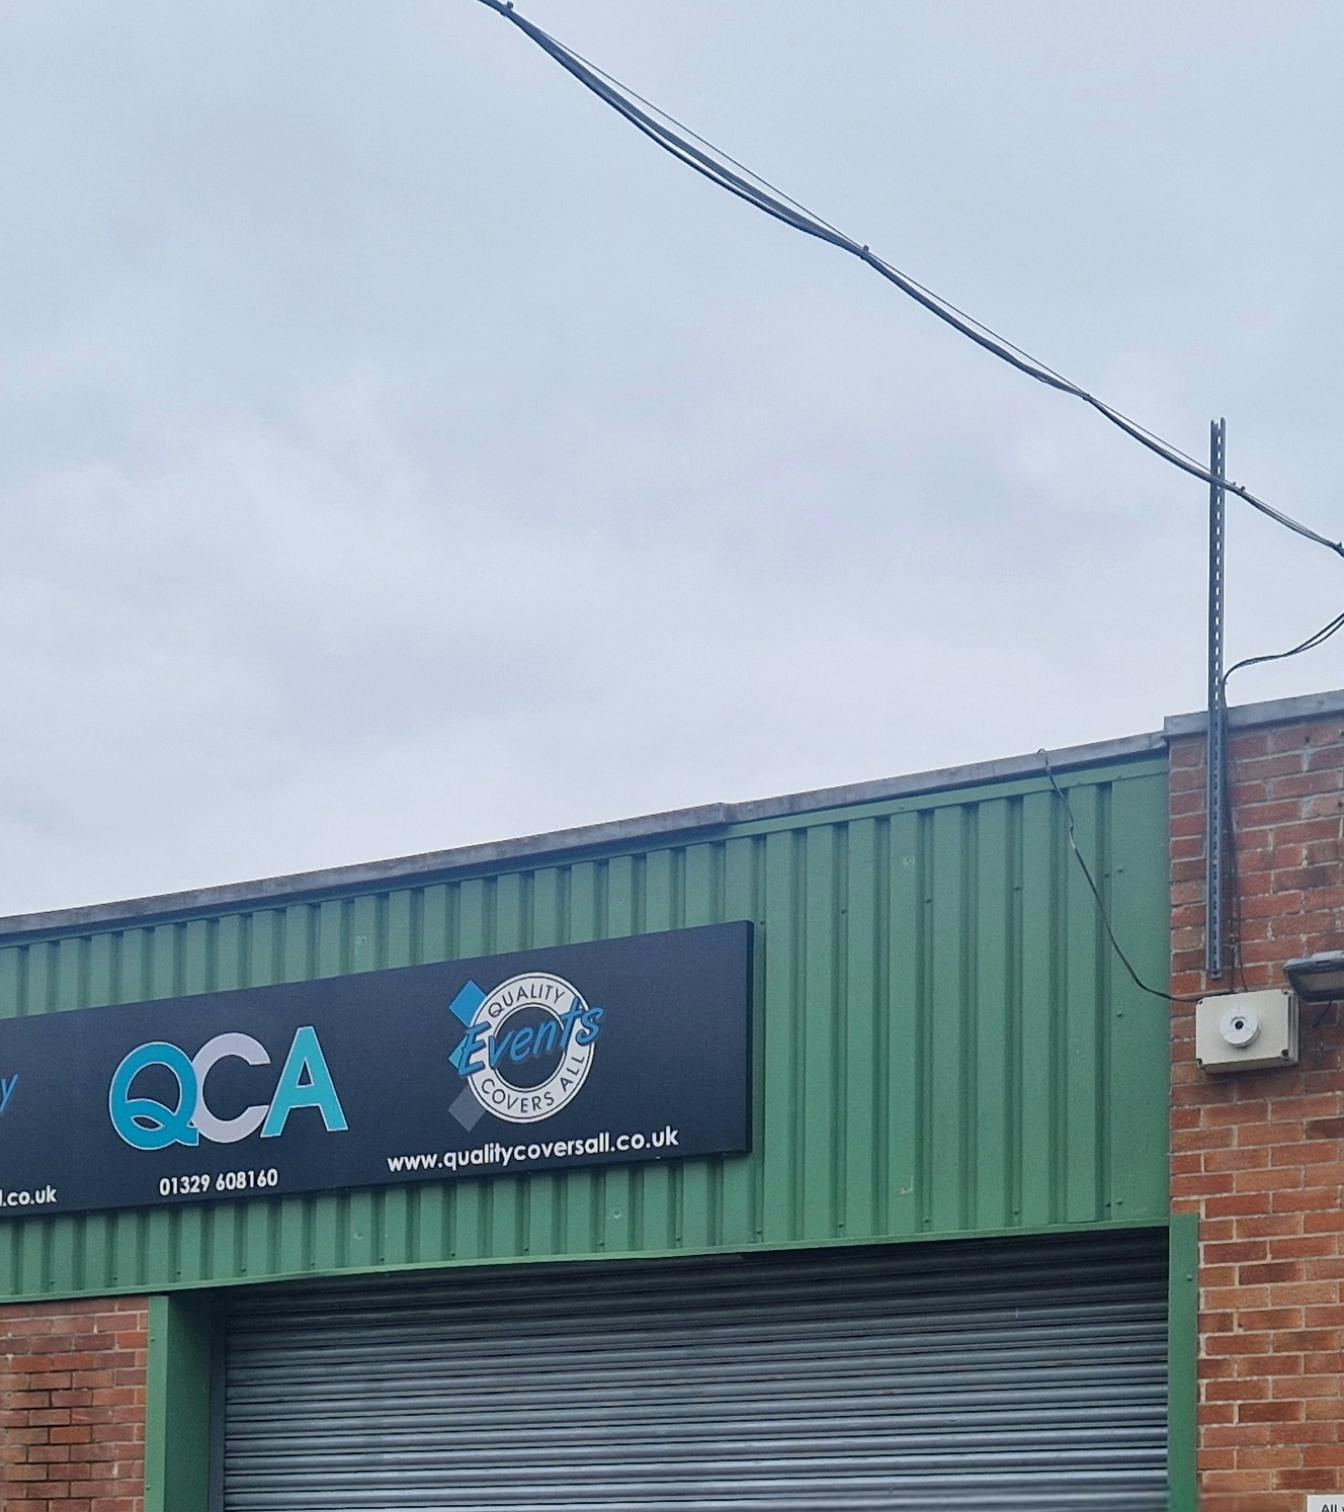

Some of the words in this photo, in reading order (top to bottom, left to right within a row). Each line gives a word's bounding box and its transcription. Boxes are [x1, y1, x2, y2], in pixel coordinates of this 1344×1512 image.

[488, 984, 565, 1017] QUALITY
[458, 996, 604, 1078] Events
[109, 1026, 349, 1150] QCA
[481, 1078, 554, 1113] COVERS
[560, 1056, 585, 1091] ALL
[387, 1126, 679, 1172] www.qualitycoversall.co.uk
[159, 1174, 210, 1196] 01329
[216, 1168, 278, 1191] 608160
